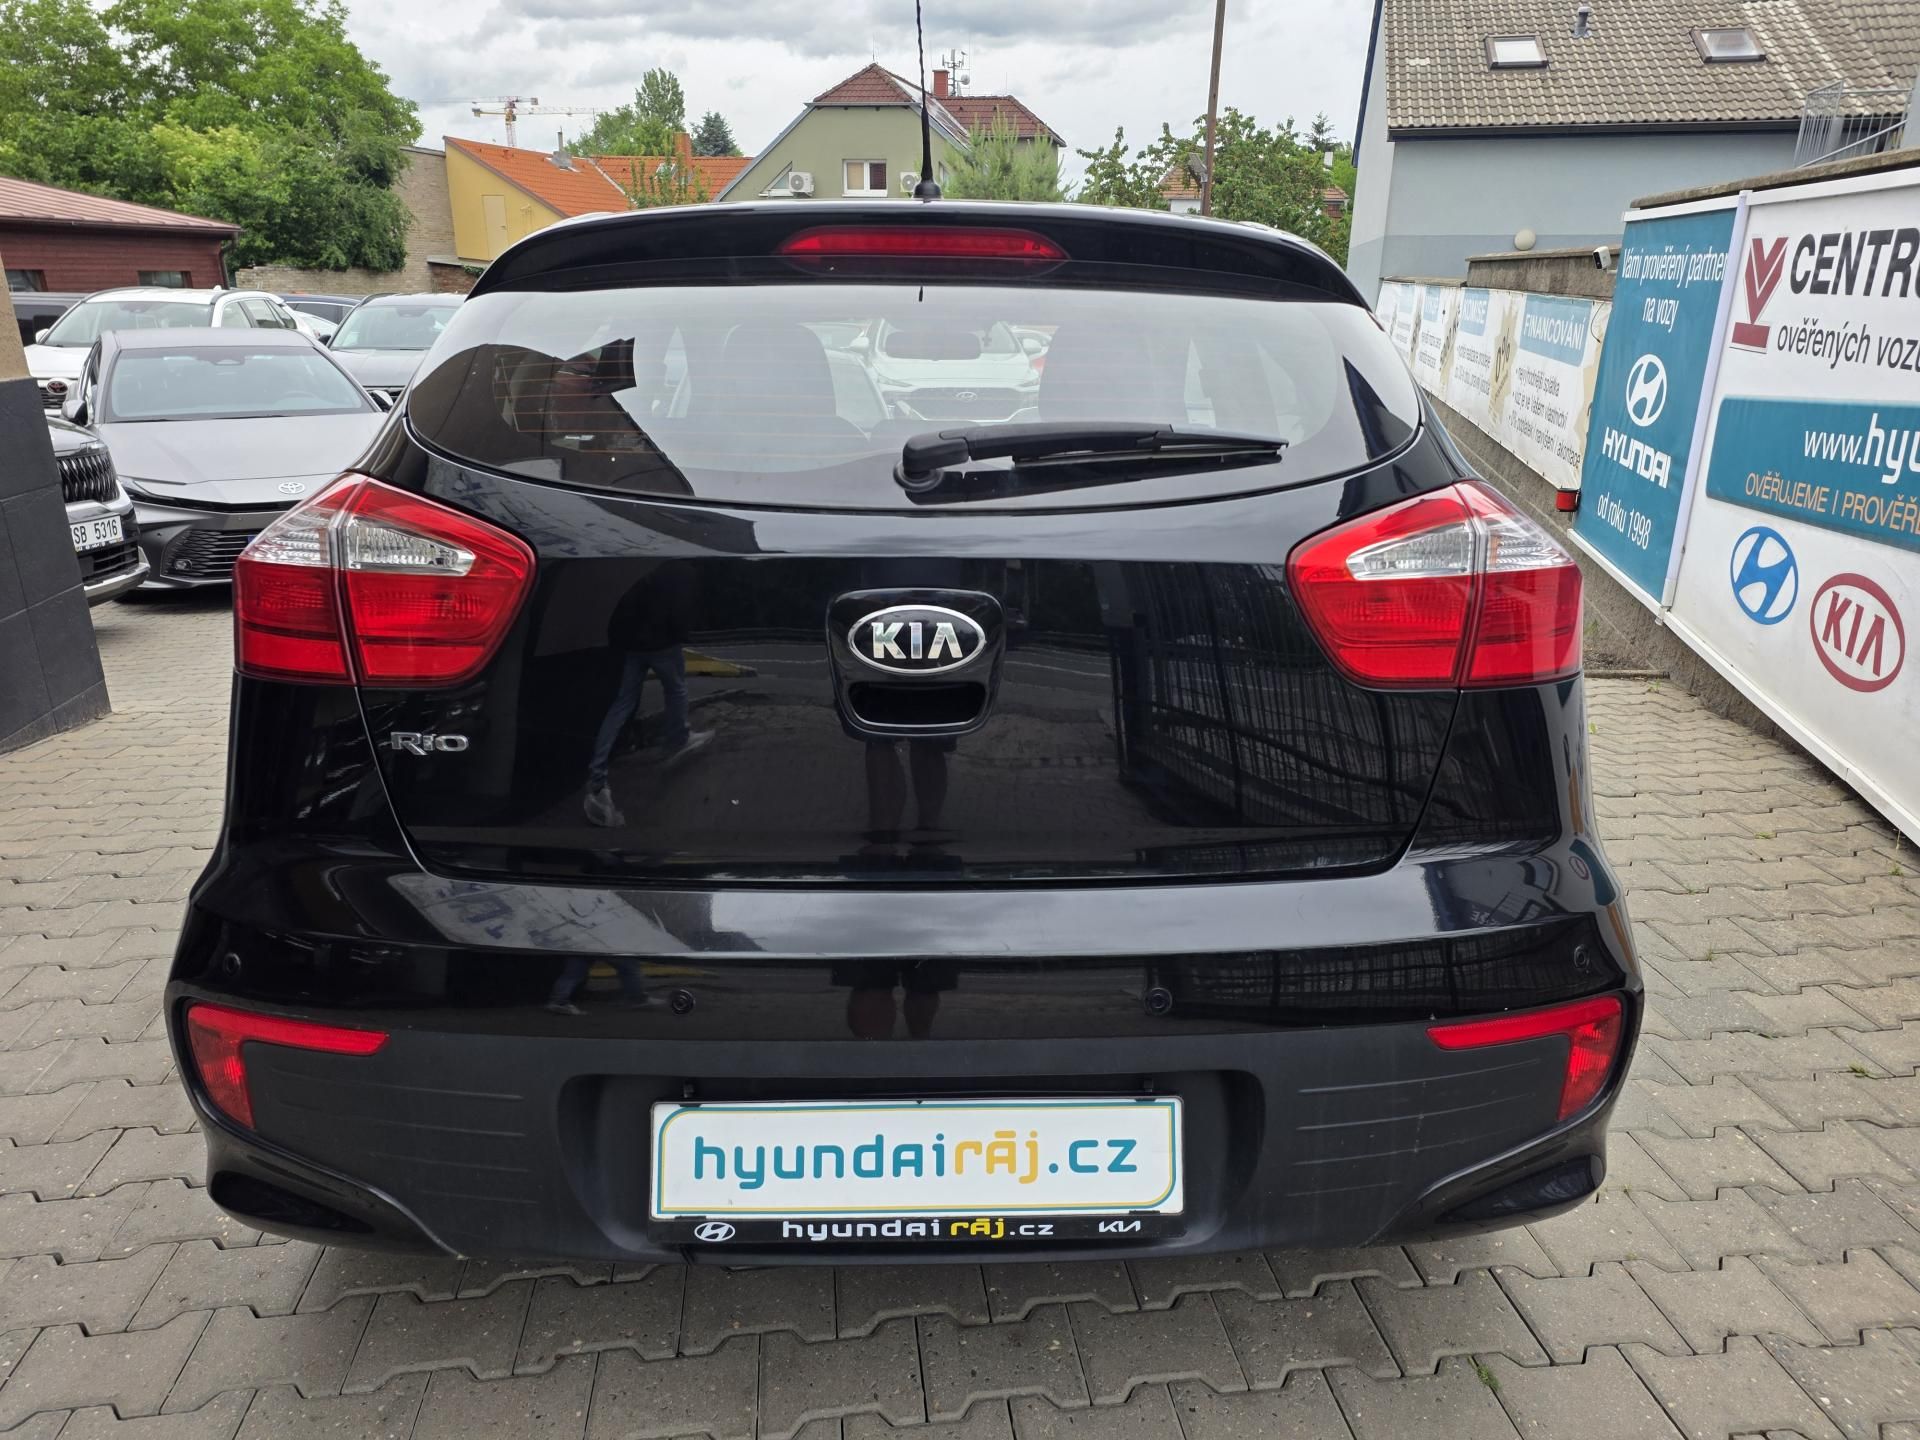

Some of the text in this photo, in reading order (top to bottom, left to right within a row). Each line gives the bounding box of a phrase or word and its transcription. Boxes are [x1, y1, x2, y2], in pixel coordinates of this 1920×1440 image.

[1640, 244, 1690, 288] prověřený
[1790, 227, 1920, 298] CENTR
[1523, 314, 1587, 350] FINANCOVÁNÍ
[1642, 297, 1679, 333] na vozy
[1777, 317, 1871, 369] ověřených
[1602, 426, 1671, 488] HYUNDAI
[1745, 470, 1830, 513] OVĚŘUJEME
[1831, 490, 1839, 515] I
[94, 519, 118, 540] 5316
[1597, 491, 1651, 550] od roku 1998
[871, 621, 963, 659] KIA
[1822, 590, 1886, 677] KIA
